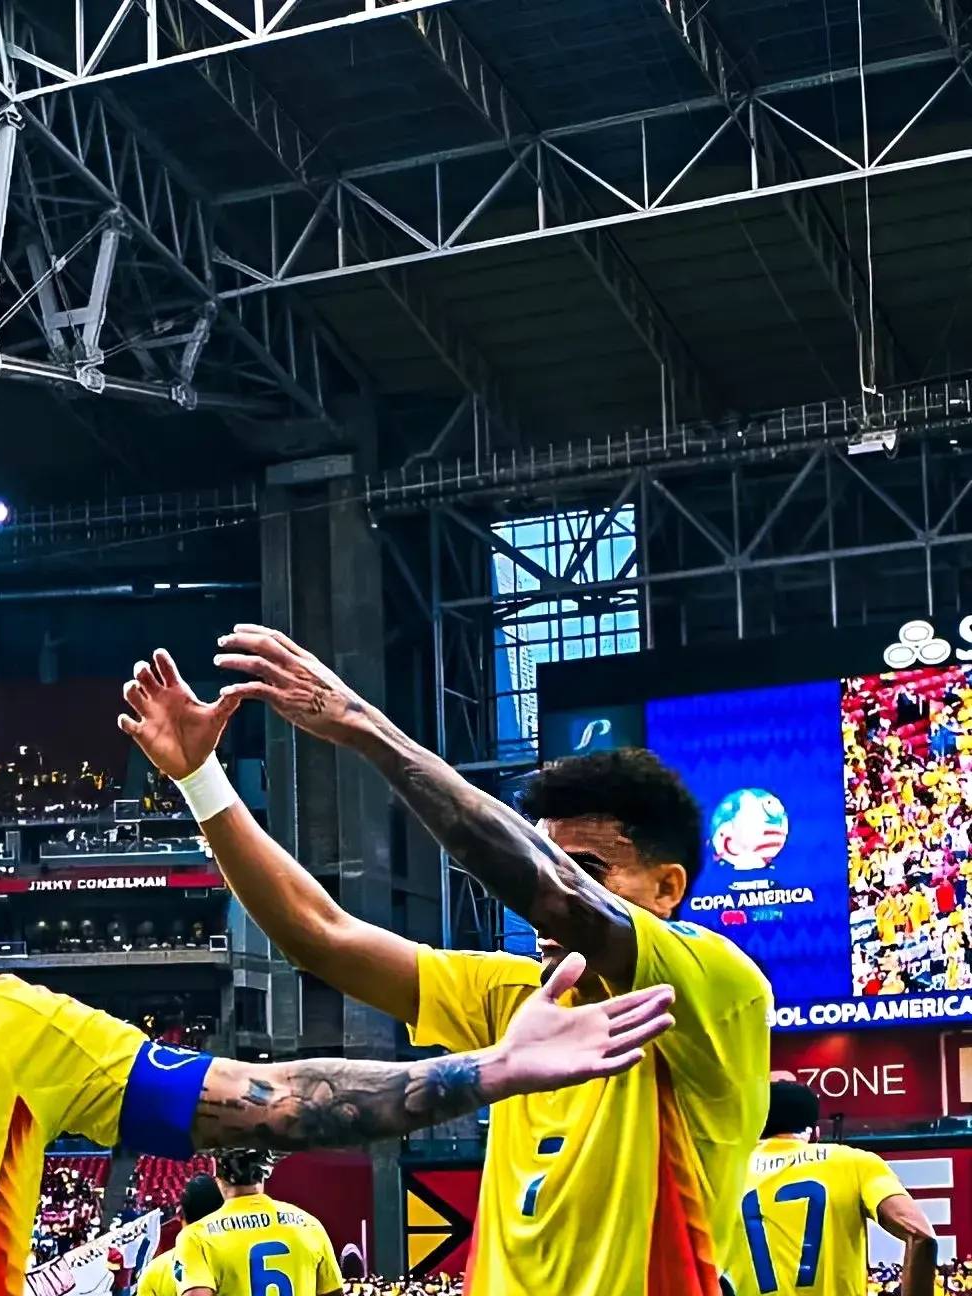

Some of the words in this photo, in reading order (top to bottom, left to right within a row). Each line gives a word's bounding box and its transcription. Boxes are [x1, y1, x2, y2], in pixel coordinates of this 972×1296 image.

[28, 880, 72, 891] JIMMY
[690, 894, 735, 911] COPA
[737, 887, 814, 907] AMERICA
[809, 1002, 870, 1024] COPA
[872, 995, 972, 1021] AMERICA
[797, 1064, 906, 1098] ZONE
[741, 1180, 827, 1295] 17
